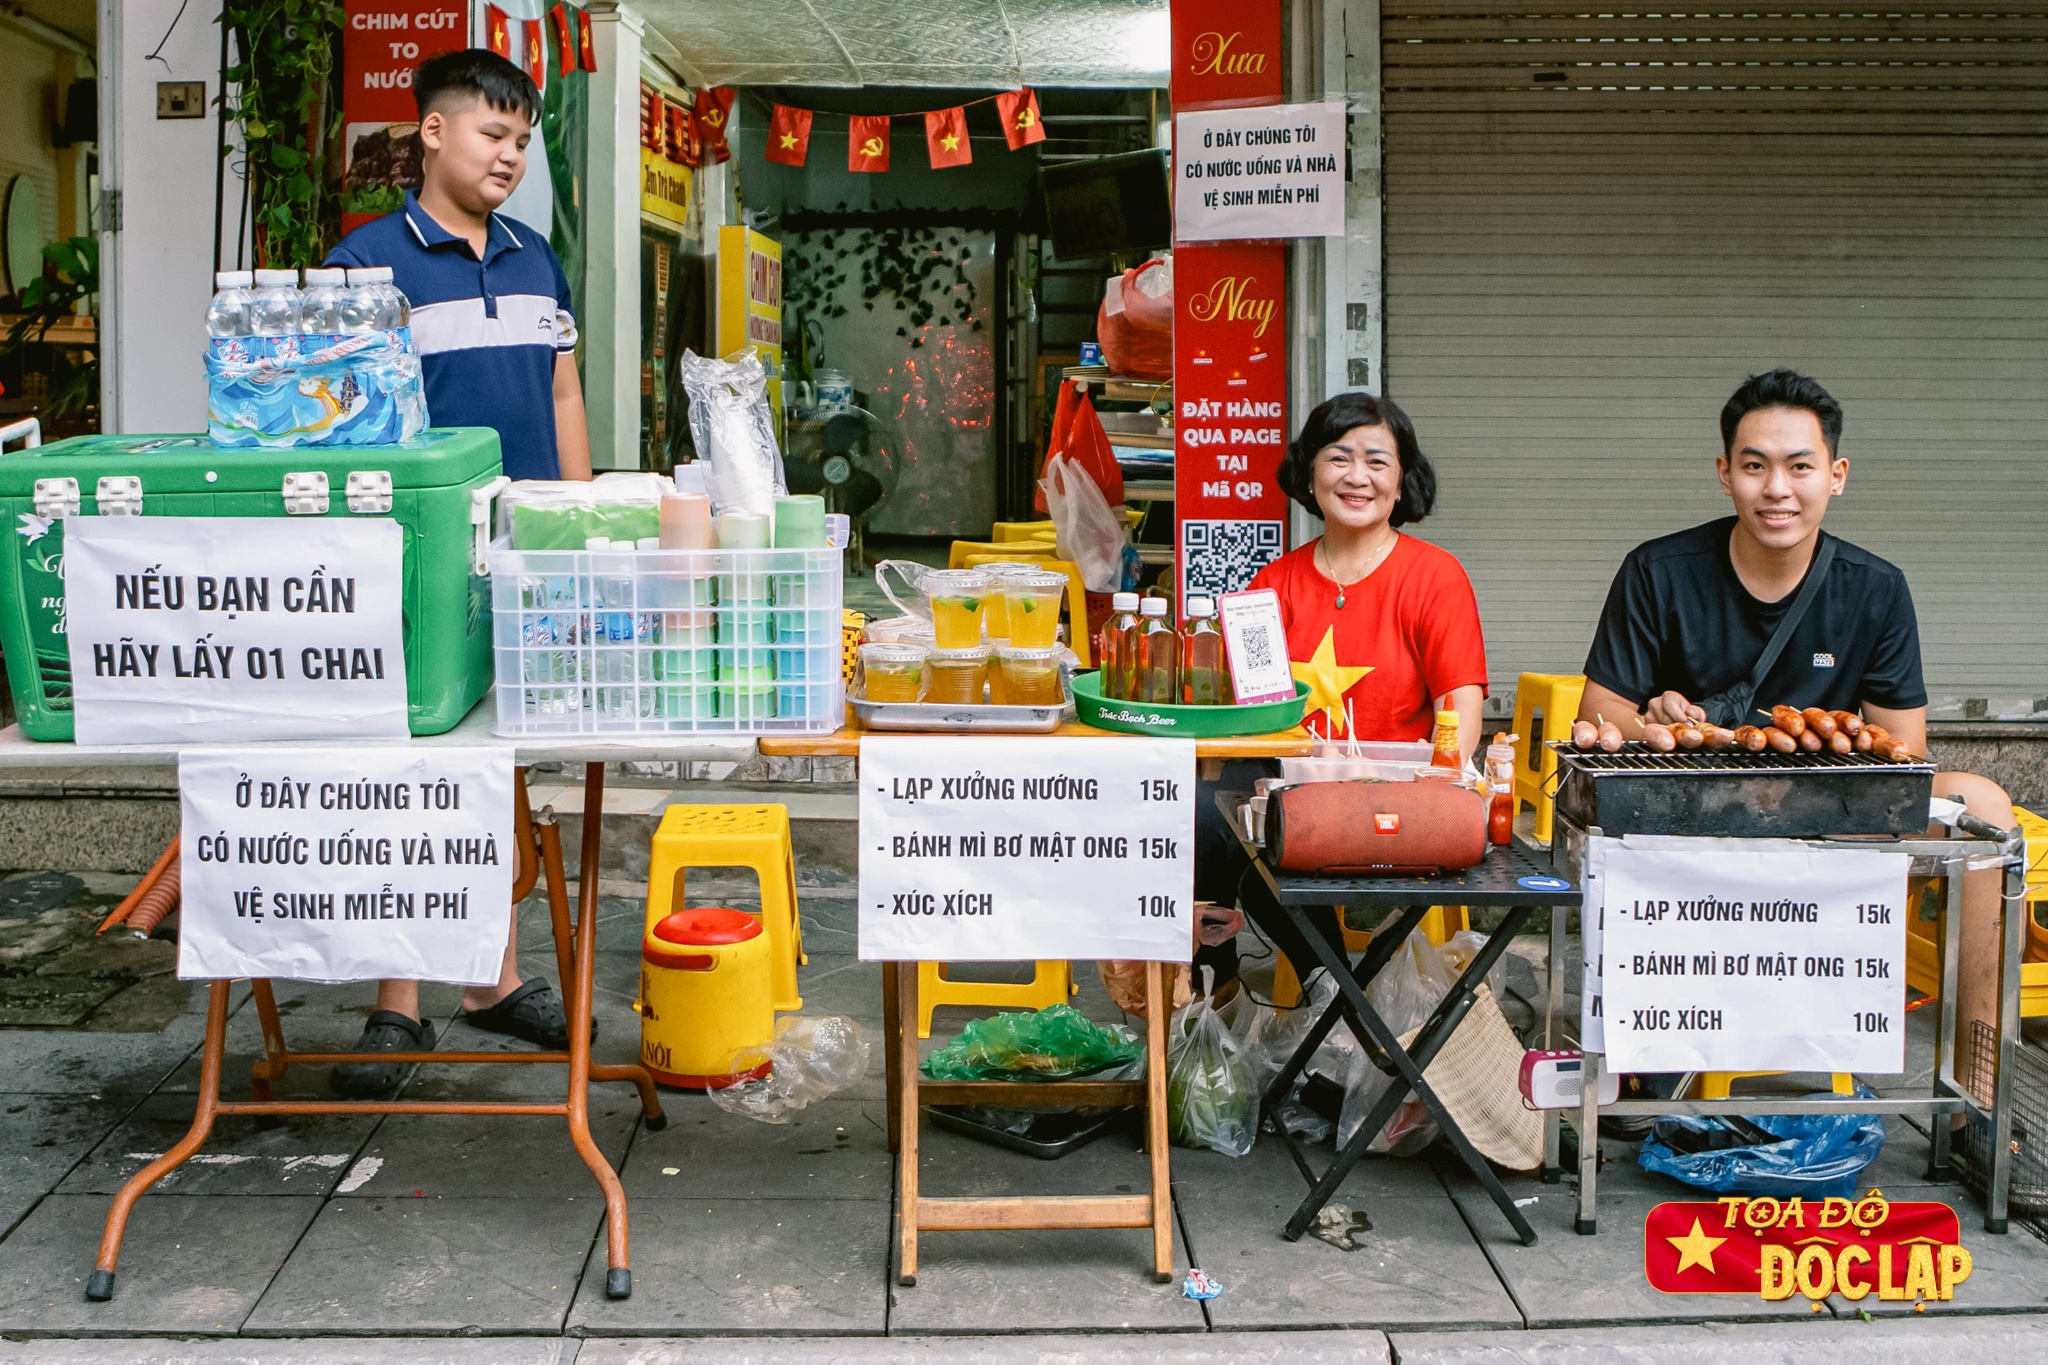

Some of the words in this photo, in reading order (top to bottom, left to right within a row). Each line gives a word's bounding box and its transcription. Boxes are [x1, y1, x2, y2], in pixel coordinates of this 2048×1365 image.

[352, 13, 408, 30] CHIM
[415, 8, 459, 29] CÚT
[389, 42, 419, 59] TO
[1191, 31, 1269, 75] Xưa
[364, 67, 413, 89] NƯỚ
[1204, 128, 1213, 148] Ở
[1216, 129, 1241, 147] ĐÂY
[1246, 126, 1291, 146] CHÚNG
[1295, 124, 1316, 143] TÔI
[1186, 160, 1202, 178] CÓ
[1207, 159, 1242, 177] NƯỚC
[1247, 155, 1281, 175] UỐNG
[1286, 155, 1302, 173] VÀ
[1307, 154, 1337, 173] NHÀ
[1204, 189, 1218, 210] VỆ
[1223, 190, 1253, 206] SINH
[1258, 183, 1292, 204] MIỄN
[1297, 184, 1320, 203] PHÍ
[1189, 276, 1278, 338] Nay
[1183, 398, 1222, 421] ĐẶT
[1227, 398, 1281, 417] HÀNG
[1184, 429, 1226, 447] QUA
[1231, 429, 1281, 444] PAGE
[1217, 455, 1248, 475] TẠI
[1203, 480, 1230, 497] Mã
[1235, 482, 1263, 500] QR
[115, 564, 185, 610] NẾU
[197, 576, 270, 620] BẠN
[283, 564, 356, 613] CẦN
[93, 636, 160, 677] HÃY
[172, 633, 235, 679] LẤY
[247, 647, 286, 680] 01
[301, 647, 385, 680] CHAI
[1146, 714, 1177, 726] Beer
[236, 772, 253, 809] Ở
[260, 776, 311, 809] ĐÂY
[320, 777, 411, 810] CHÚNG
[420, 777, 460, 810] TÔI
[893, 777, 933, 804] LẠP
[940, 770, 1015, 801] XƯỞNG
[1023, 773, 1099, 801] NƯỚNG
[1140, 779, 1179, 802] 15k
[1379, 820, 1395, 829] JBL
[198, 830, 230, 863] CÓ
[238, 831, 310, 865] NƯỚC
[319, 828, 392, 865] UỐNG
[400, 832, 436, 865] VÀ
[444, 832, 499, 866] NHÀ
[892, 831, 952, 858] BÁNH
[959, 831, 986, 858] MÌ
[993, 833, 1023, 858] BƠ
[1029, 831, 1076, 862] MẬT
[1083, 836, 1128, 859] ONG
[1139, 837, 1178, 860] 15k
[233, 885, 264, 923] VỆ
[273, 891, 335, 921] SINH
[344, 882, 415, 920] MIỄN
[425, 886, 469, 920] PHÍ
[892, 889, 935, 916] XÚC
[942, 888, 993, 916] XÍCH
[1138, 895, 1176, 918] 10k
[1633, 900, 1670, 925] LẠP
[1676, 894, 1744, 922] XƯỞNG
[1750, 898, 1818, 923] NƯỚNG
[1856, 904, 1891, 925] 15k
[1633, 951, 1686, 976] BÁNH
[1693, 951, 1717, 976] MÌ
[1723, 953, 1749, 976] BƠ
[1756, 951, 1798, 981] MẬT
[1804, 956, 1844, 978] ONG
[1854, 958, 1890, 979] 15k
[1632, 1005, 1670, 1031] XÚC
[1677, 1005, 1722, 1031] XÍCH
[1853, 1012, 1889, 1033] 10k
